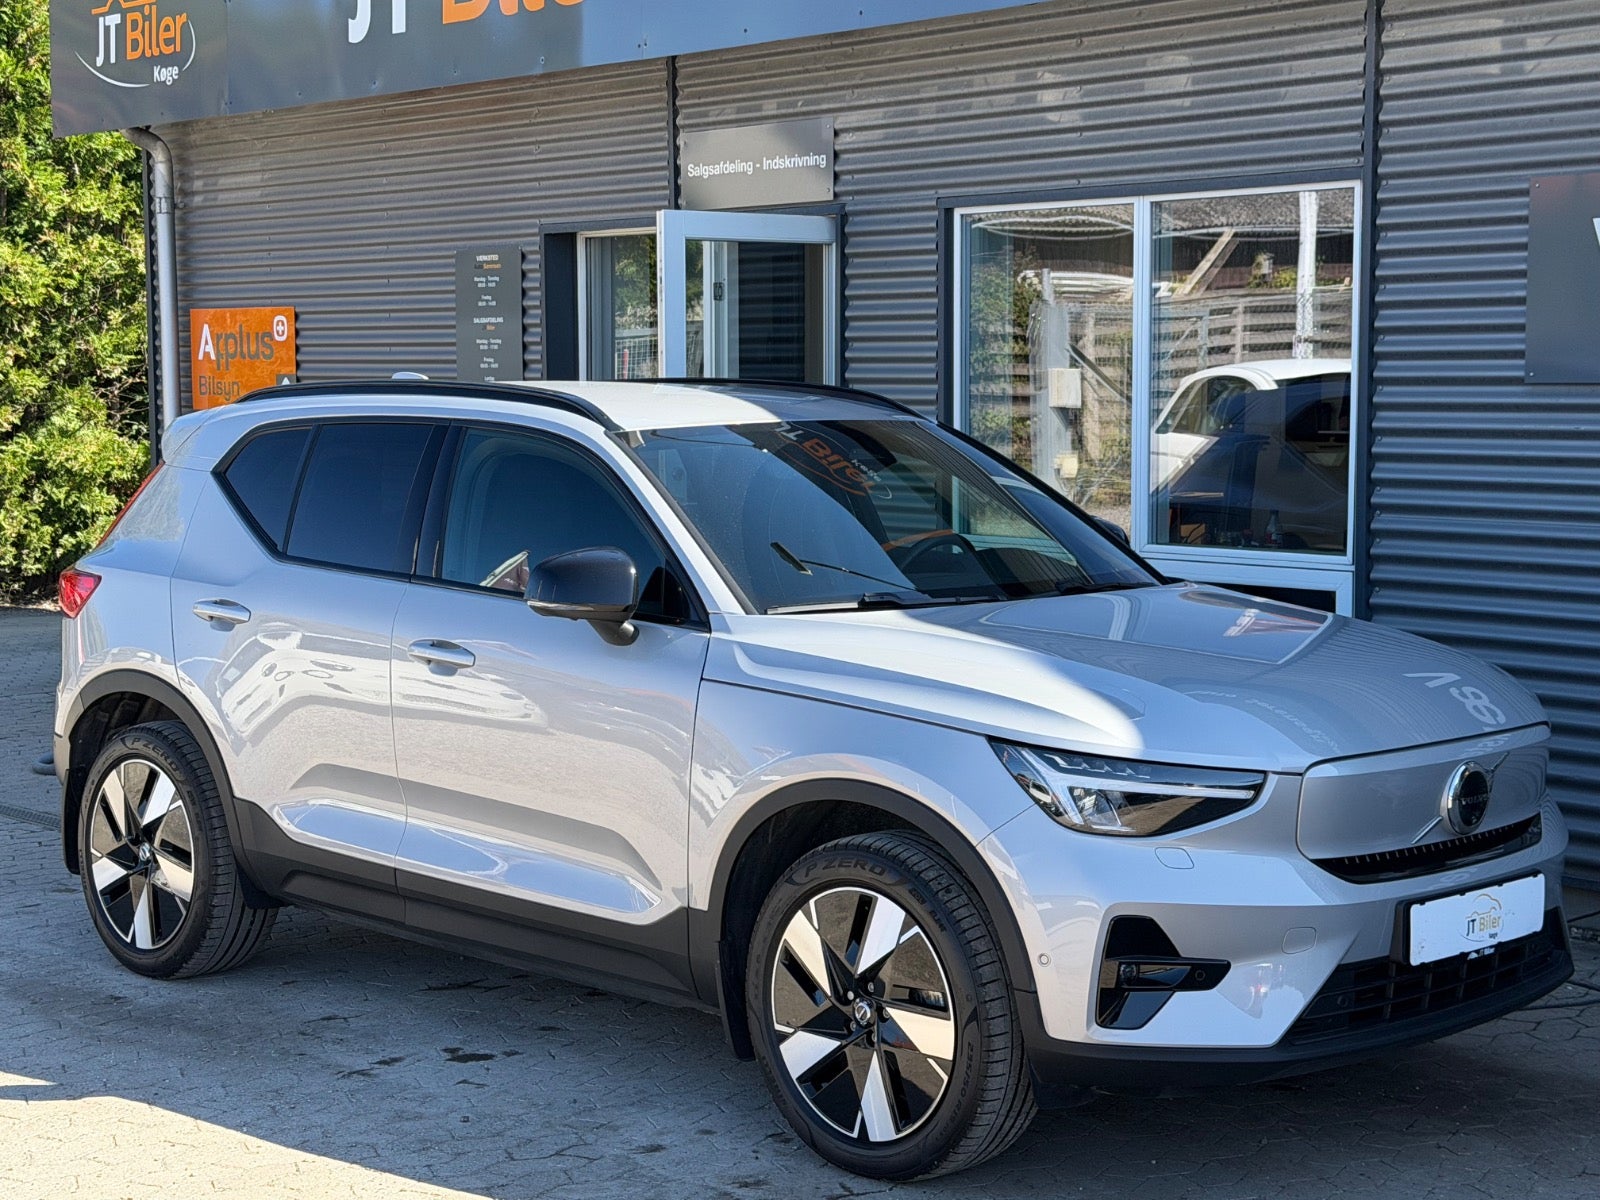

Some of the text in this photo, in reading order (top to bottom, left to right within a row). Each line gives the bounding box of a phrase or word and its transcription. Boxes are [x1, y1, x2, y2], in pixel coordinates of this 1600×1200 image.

[96, 4, 187, 67] JT Biler
[153, 65, 179, 86] Køge
[687, 159, 753, 179] Salgsafdeling
[763, 152, 827, 171] Indskrivning
[199, 375, 240, 401] Bilsyn
[822, 857, 887, 877] ZERO
[1466, 919, 1477, 937] JT
[1479, 914, 1501, 932] Biler
